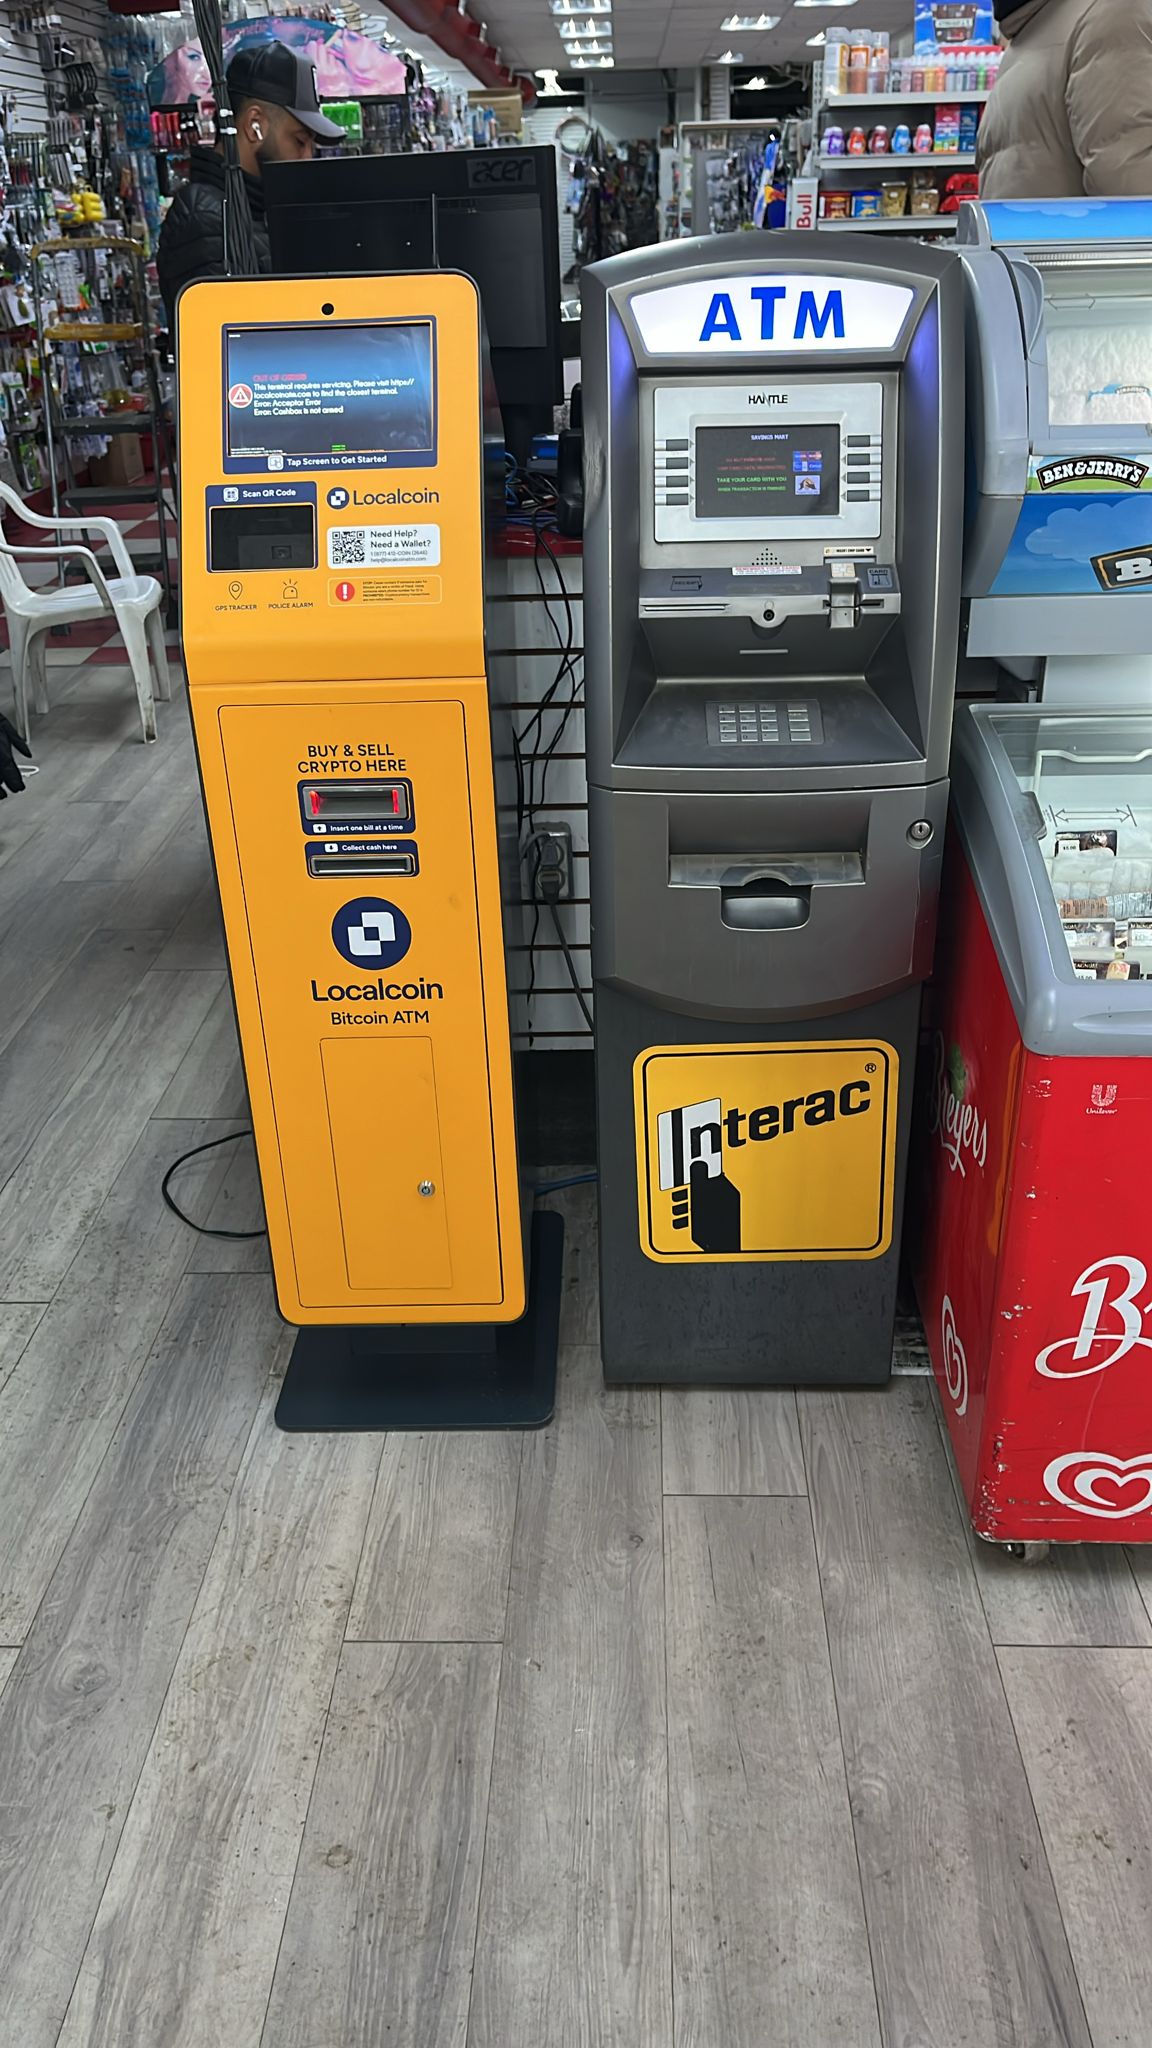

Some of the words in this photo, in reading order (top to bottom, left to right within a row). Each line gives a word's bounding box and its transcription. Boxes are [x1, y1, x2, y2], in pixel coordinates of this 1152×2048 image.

[474, 159, 533, 182] acer
[797, 194, 812, 228] Bull
[699, 286, 845, 342] ATM
[267, 382, 293, 390] terminal
[294, 382, 320, 391] requires
[353, 379, 375, 387] Please
[346, 388, 370, 396] closest
[272, 399, 304, 408] Acceptor
[305, 398, 321, 406] Error
[748, 394, 788, 406] HANTLE
[272, 408, 302, 416] Cashbox
[287, 458, 300, 467] Tap
[302, 457, 330, 465] Screen
[331, 456, 340, 464] to
[341, 455, 357, 464] Get
[357, 455, 387, 464] Started
[243, 490, 262, 498] Scan
[262, 489, 275, 498] QR
[276, 488, 296, 497] Code
[354, 488, 440, 506] Localcoin
[394, 529, 418, 539] Help?
[401, 540, 431, 548] Wallet?
[308, 745, 339, 758] BUY
[343, 744, 353, 757] &
[357, 743, 395, 756] SELL
[297, 760, 362, 773] CRYPTO
[366, 759, 407, 772] HERE
[310, 977, 444, 1002] Localcoin
[331, 1011, 389, 1025] Bitcoin
[393, 1010, 430, 1024] ATM
[928, 1030, 988, 1178] Breyers
[1086, 1107, 1118, 1115] Unilever
[671, 1080, 871, 1188] Interac
